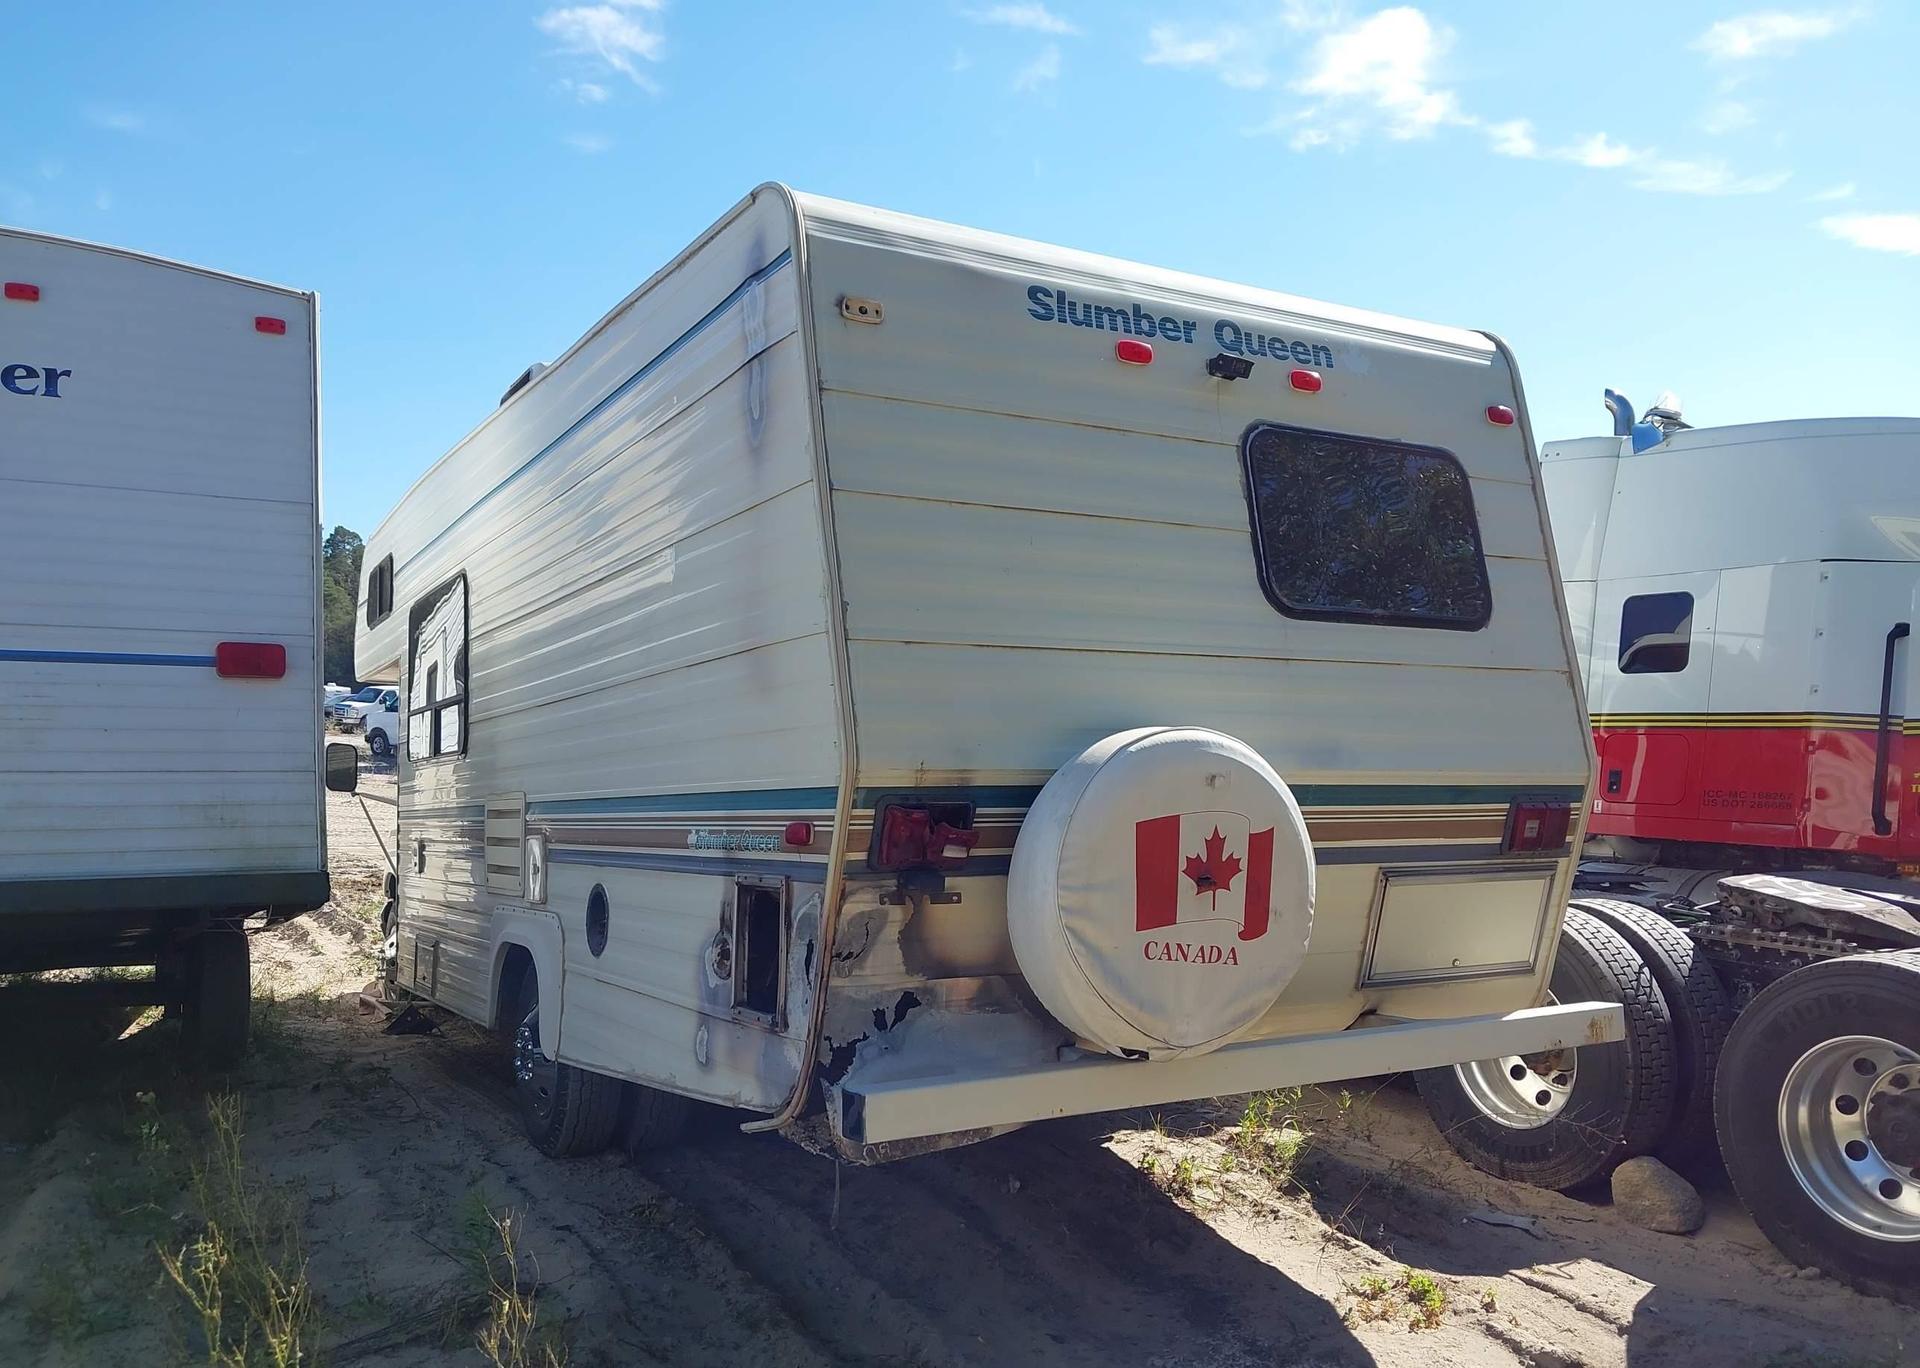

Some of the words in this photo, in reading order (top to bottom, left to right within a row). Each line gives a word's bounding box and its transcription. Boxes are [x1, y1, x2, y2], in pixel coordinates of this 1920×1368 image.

[1027, 285, 1197, 344] Slumber
[1213, 319, 1335, 369] Queen
[1143, 940, 1239, 966] CANADA
